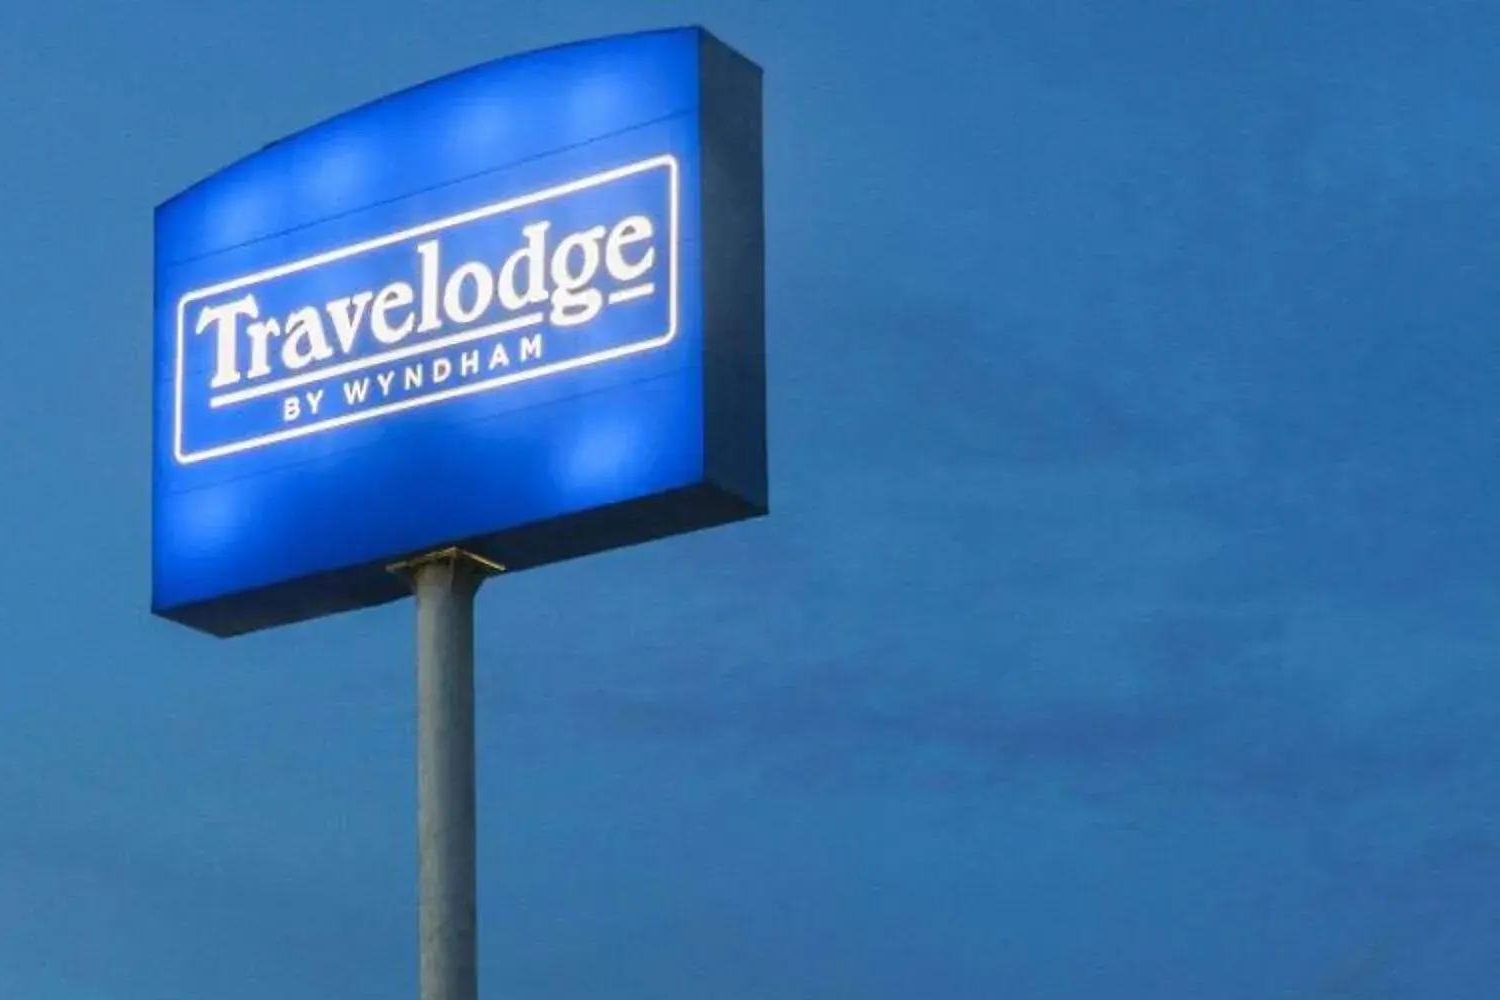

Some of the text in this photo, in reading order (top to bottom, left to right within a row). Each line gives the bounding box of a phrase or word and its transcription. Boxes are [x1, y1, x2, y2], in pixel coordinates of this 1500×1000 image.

[195, 214, 655, 388] Travelodge
[283, 332, 544, 421] BY WYNDHAM
